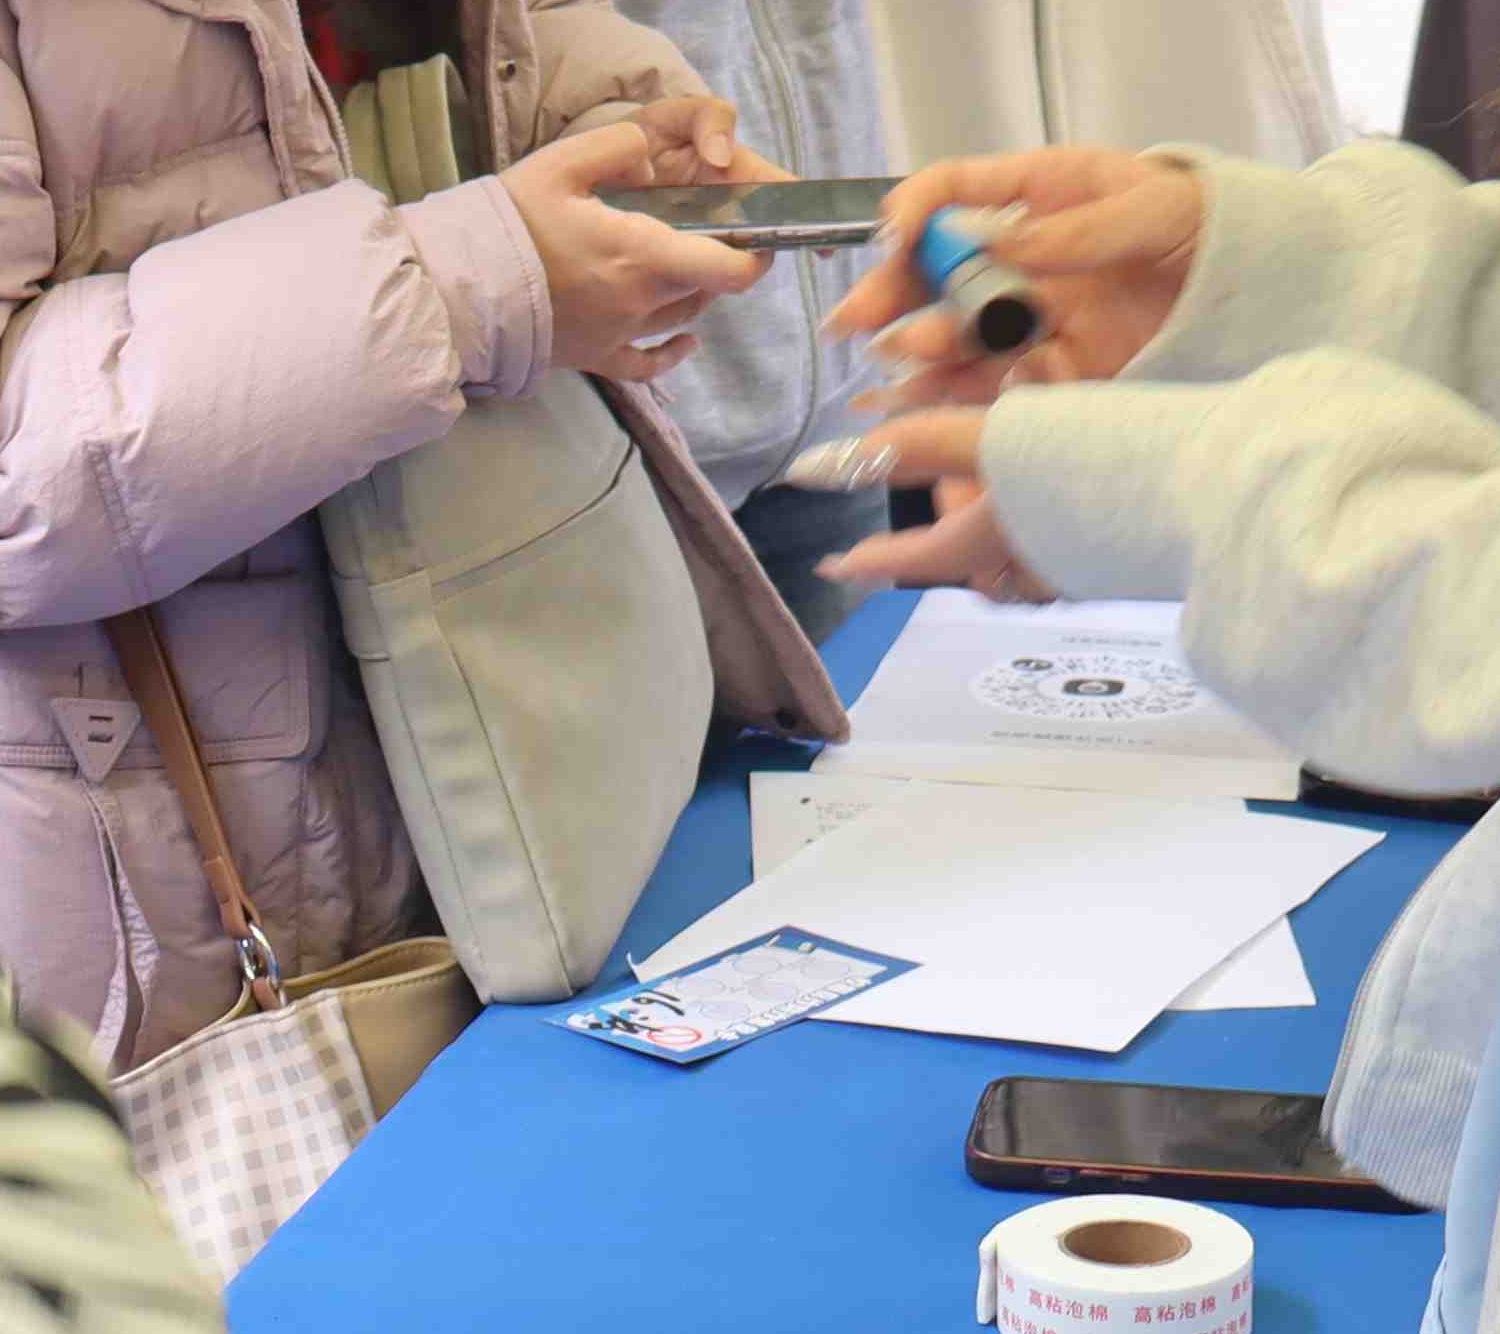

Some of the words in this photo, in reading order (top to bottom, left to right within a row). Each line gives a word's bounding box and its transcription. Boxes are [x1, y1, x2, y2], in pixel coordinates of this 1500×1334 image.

[1029, 1288, 1109, 1323] 高粘泡棉
[1133, 1294, 1217, 1324] 高粘泡棉
